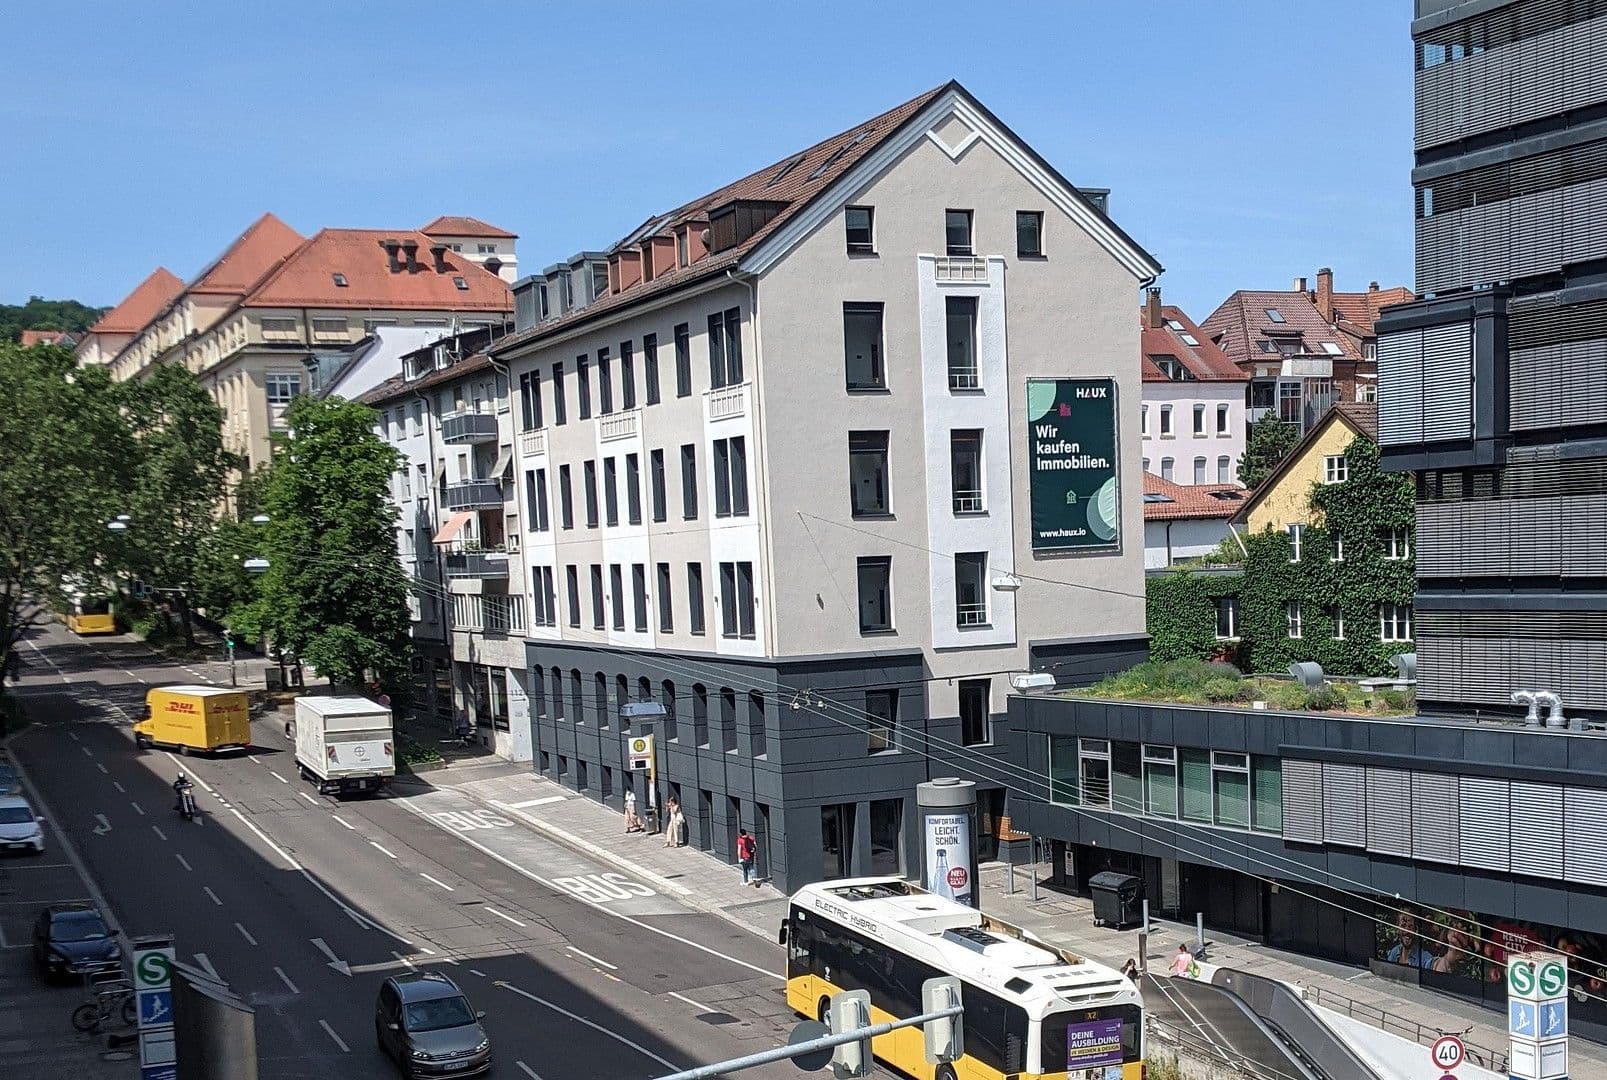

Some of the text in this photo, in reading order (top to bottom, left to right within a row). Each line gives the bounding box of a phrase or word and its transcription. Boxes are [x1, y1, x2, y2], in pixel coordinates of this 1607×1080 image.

[1076, 387, 1107, 399] HAUX
[1035, 424, 1058, 438] Wir
[1036, 440, 1080, 454] kaufen
[1036, 455, 1110, 470] Immobilien.
[1040, 527, 1086, 538] www.haux.io
[431, 809, 515, 831] BUS
[934, 826, 961, 835] LEICHT.
[551, 872, 657, 904] BUS
[815, 899, 877, 933] ELECTRIC HYBRID
[141, 956, 167, 981] S
[1514, 965, 1530, 989] S
[1544, 966, 1561, 992] S
[1071, 1030, 1094, 1040] DEINE
[1071, 1035, 1120, 1048] AUSBILDUNG
[1439, 1045, 1458, 1061] 40
